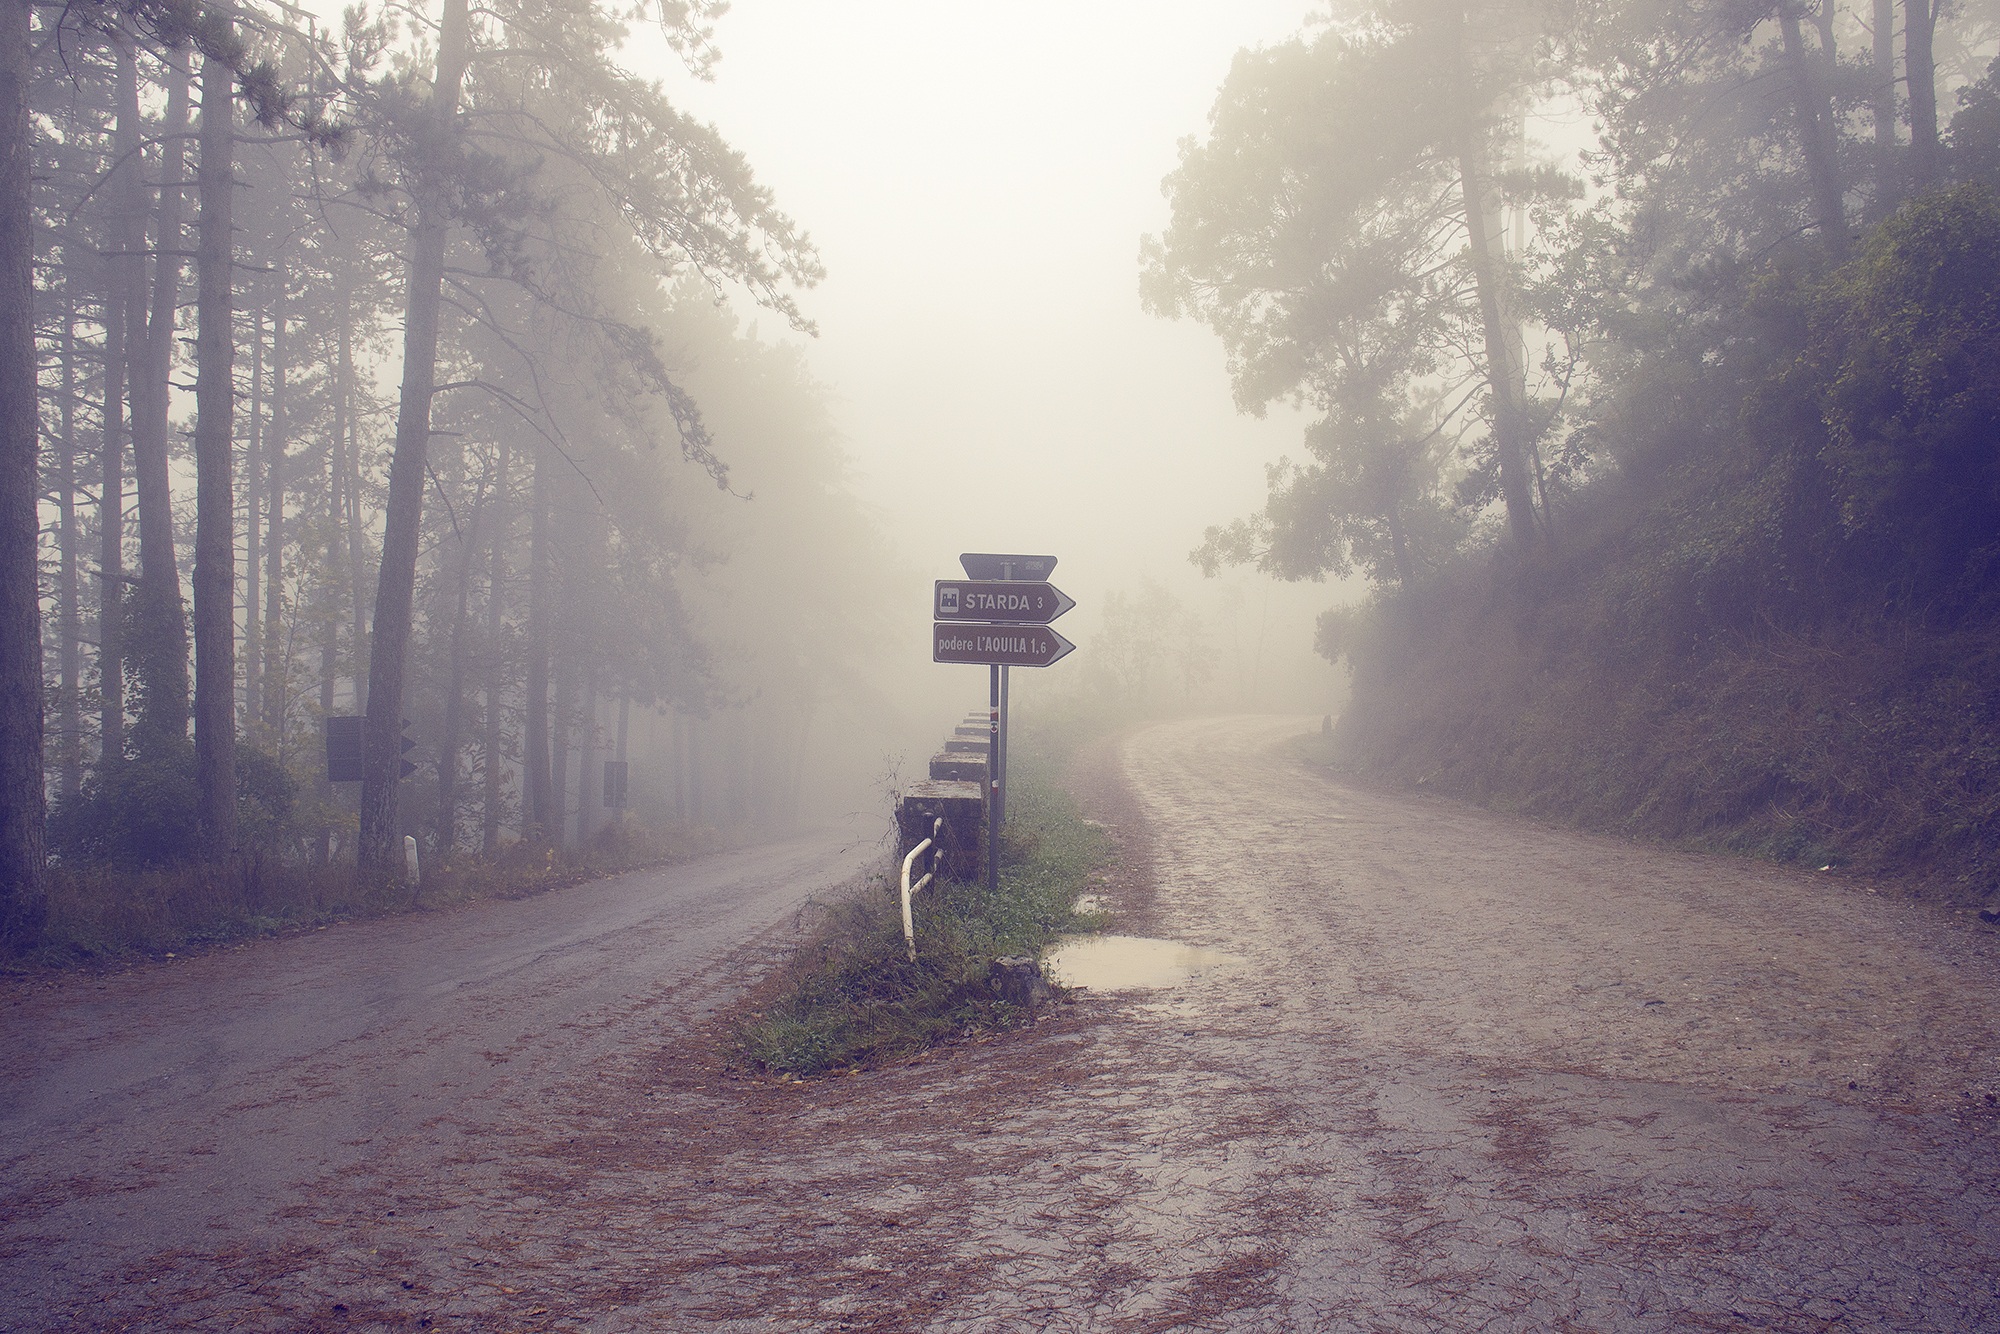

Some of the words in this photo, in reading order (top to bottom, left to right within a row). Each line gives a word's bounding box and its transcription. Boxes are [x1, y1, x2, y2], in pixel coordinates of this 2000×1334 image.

[965, 594, 1030, 610] STARDA
[1037, 596, 1043, 609] 3
[938, 636, 973, 653] podere
[977, 636, 1027, 653] L'AQUILA
[1030, 638, 1047, 655] 1,6
